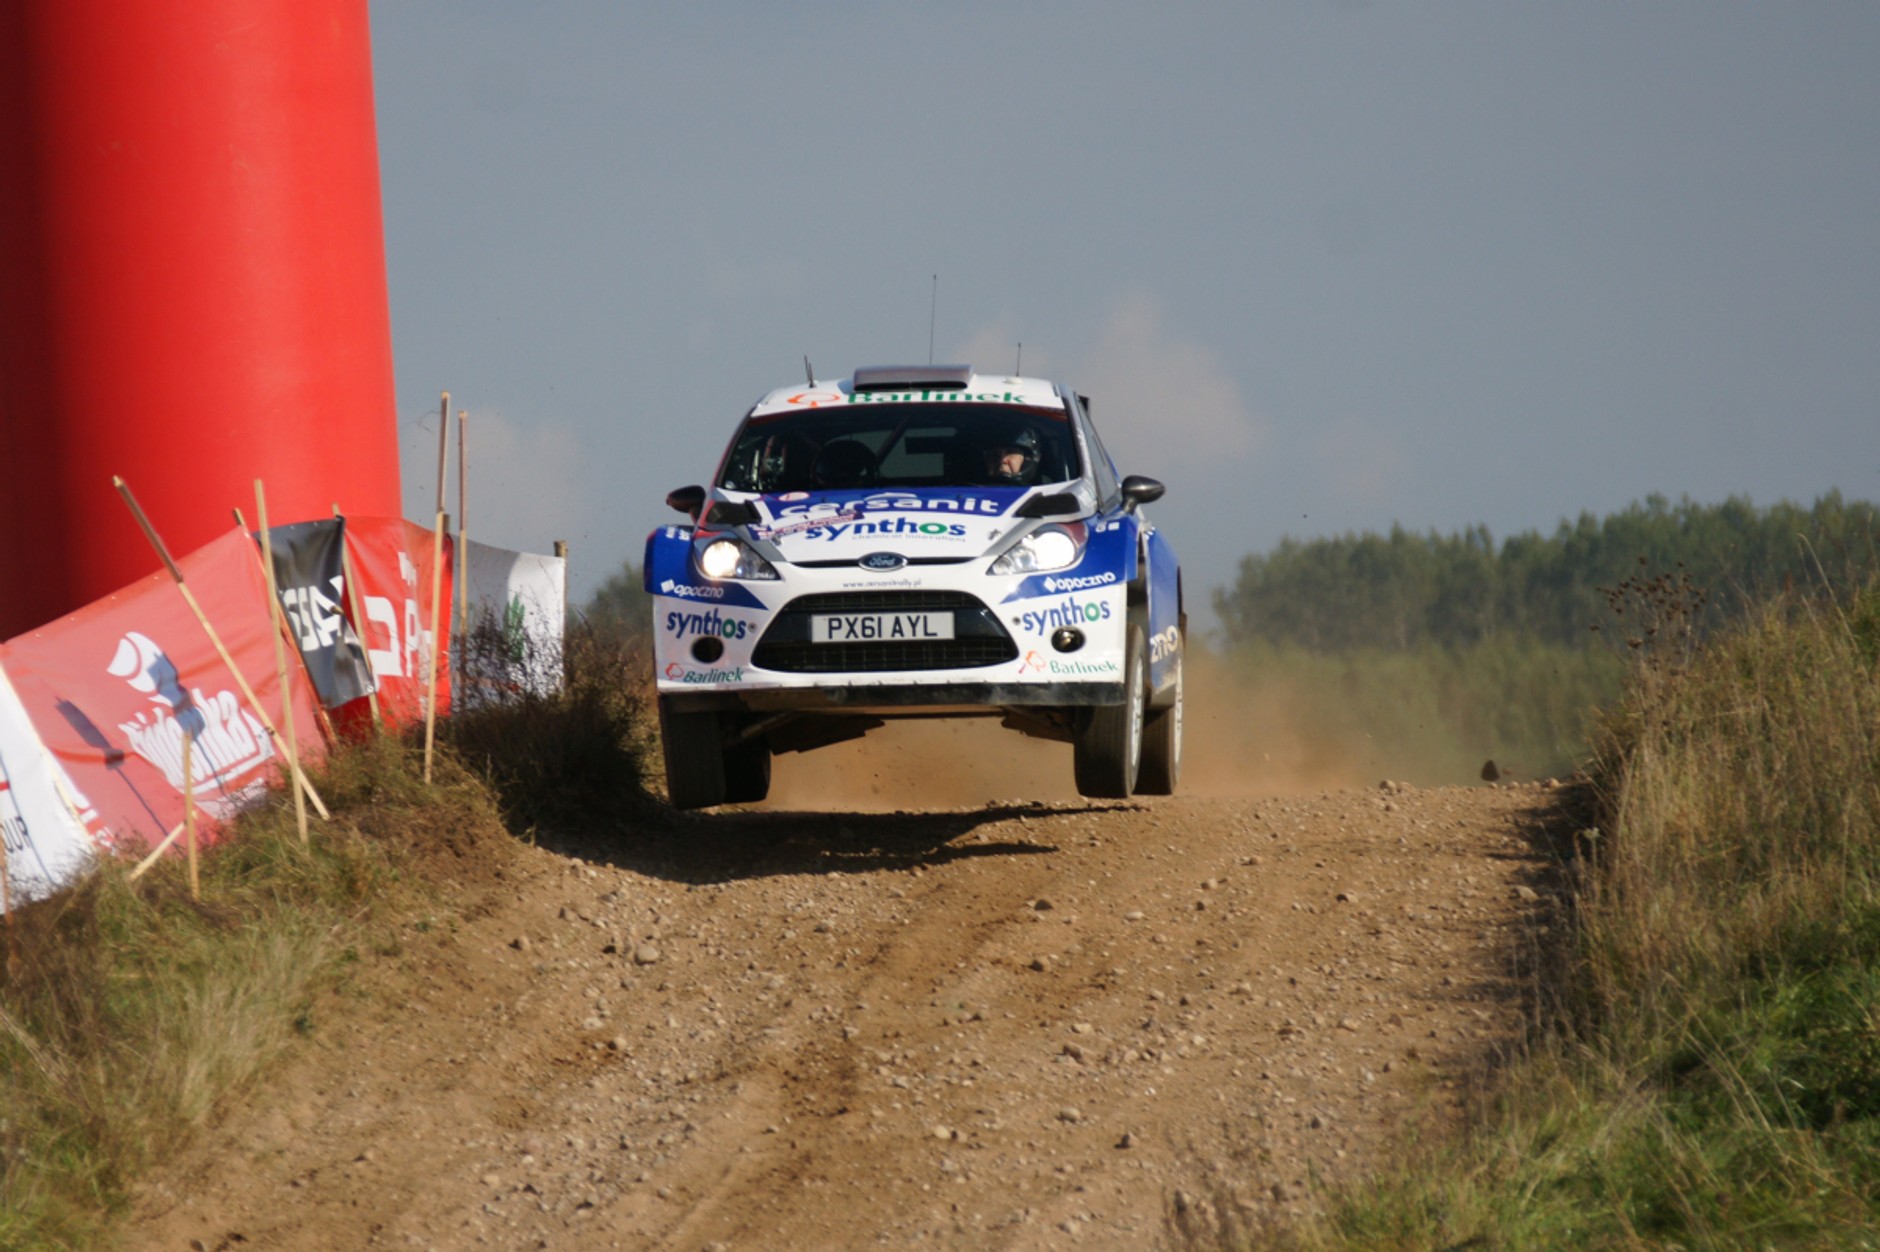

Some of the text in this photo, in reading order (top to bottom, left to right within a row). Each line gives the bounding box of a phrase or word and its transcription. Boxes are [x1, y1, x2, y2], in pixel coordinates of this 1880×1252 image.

[848, 390, 1025, 403] Barlinek
[780, 496, 999, 517] cersanit
[805, 517, 966, 541] synthos
[852, 533, 903, 541] chemical
[869, 555, 896, 567] Ford
[674, 584, 724, 598] opoczno
[843, 578, 922, 589] www.cersanitrally.pl
[1057, 572, 1116, 592] opoczno
[666, 607, 747, 640] synthos
[1023, 597, 1111, 636] synthos
[828, 615, 938, 640] PX61 AYL
[683, 666, 744, 684] Barlinek
[1050, 660, 1119, 675] Barlinek
